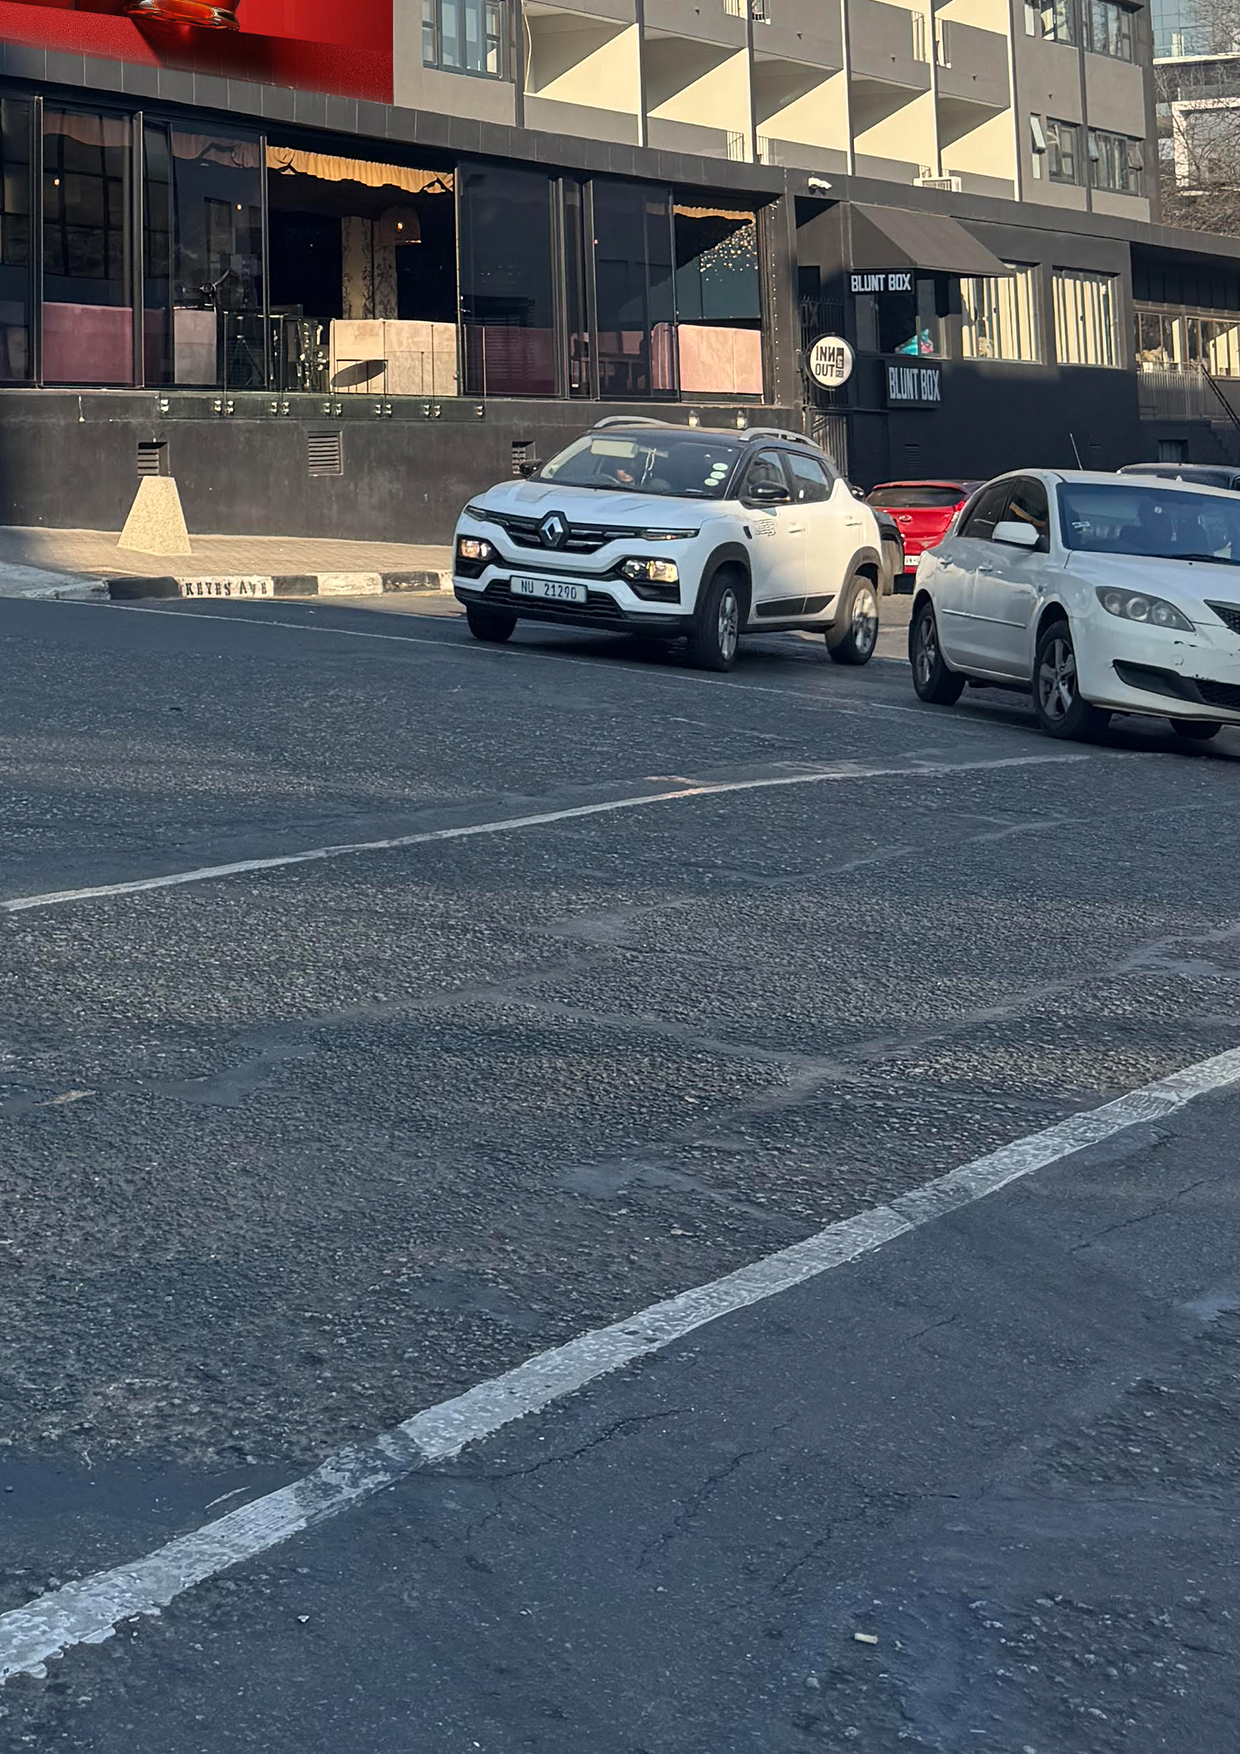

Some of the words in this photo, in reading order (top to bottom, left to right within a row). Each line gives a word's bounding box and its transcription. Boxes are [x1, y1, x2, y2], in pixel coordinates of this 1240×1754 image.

[851, 274, 886, 292] BLUNT
[888, 273, 912, 291] BOX
[815, 363, 835, 377] OUT
[888, 366, 919, 400] BLUNT
[920, 368, 942, 402] BOX
[185, 581, 232, 596] KEYES
[239, 580, 268, 596] AVE
[521, 579, 534, 593] NU
[543, 582, 577, 599] 21290
